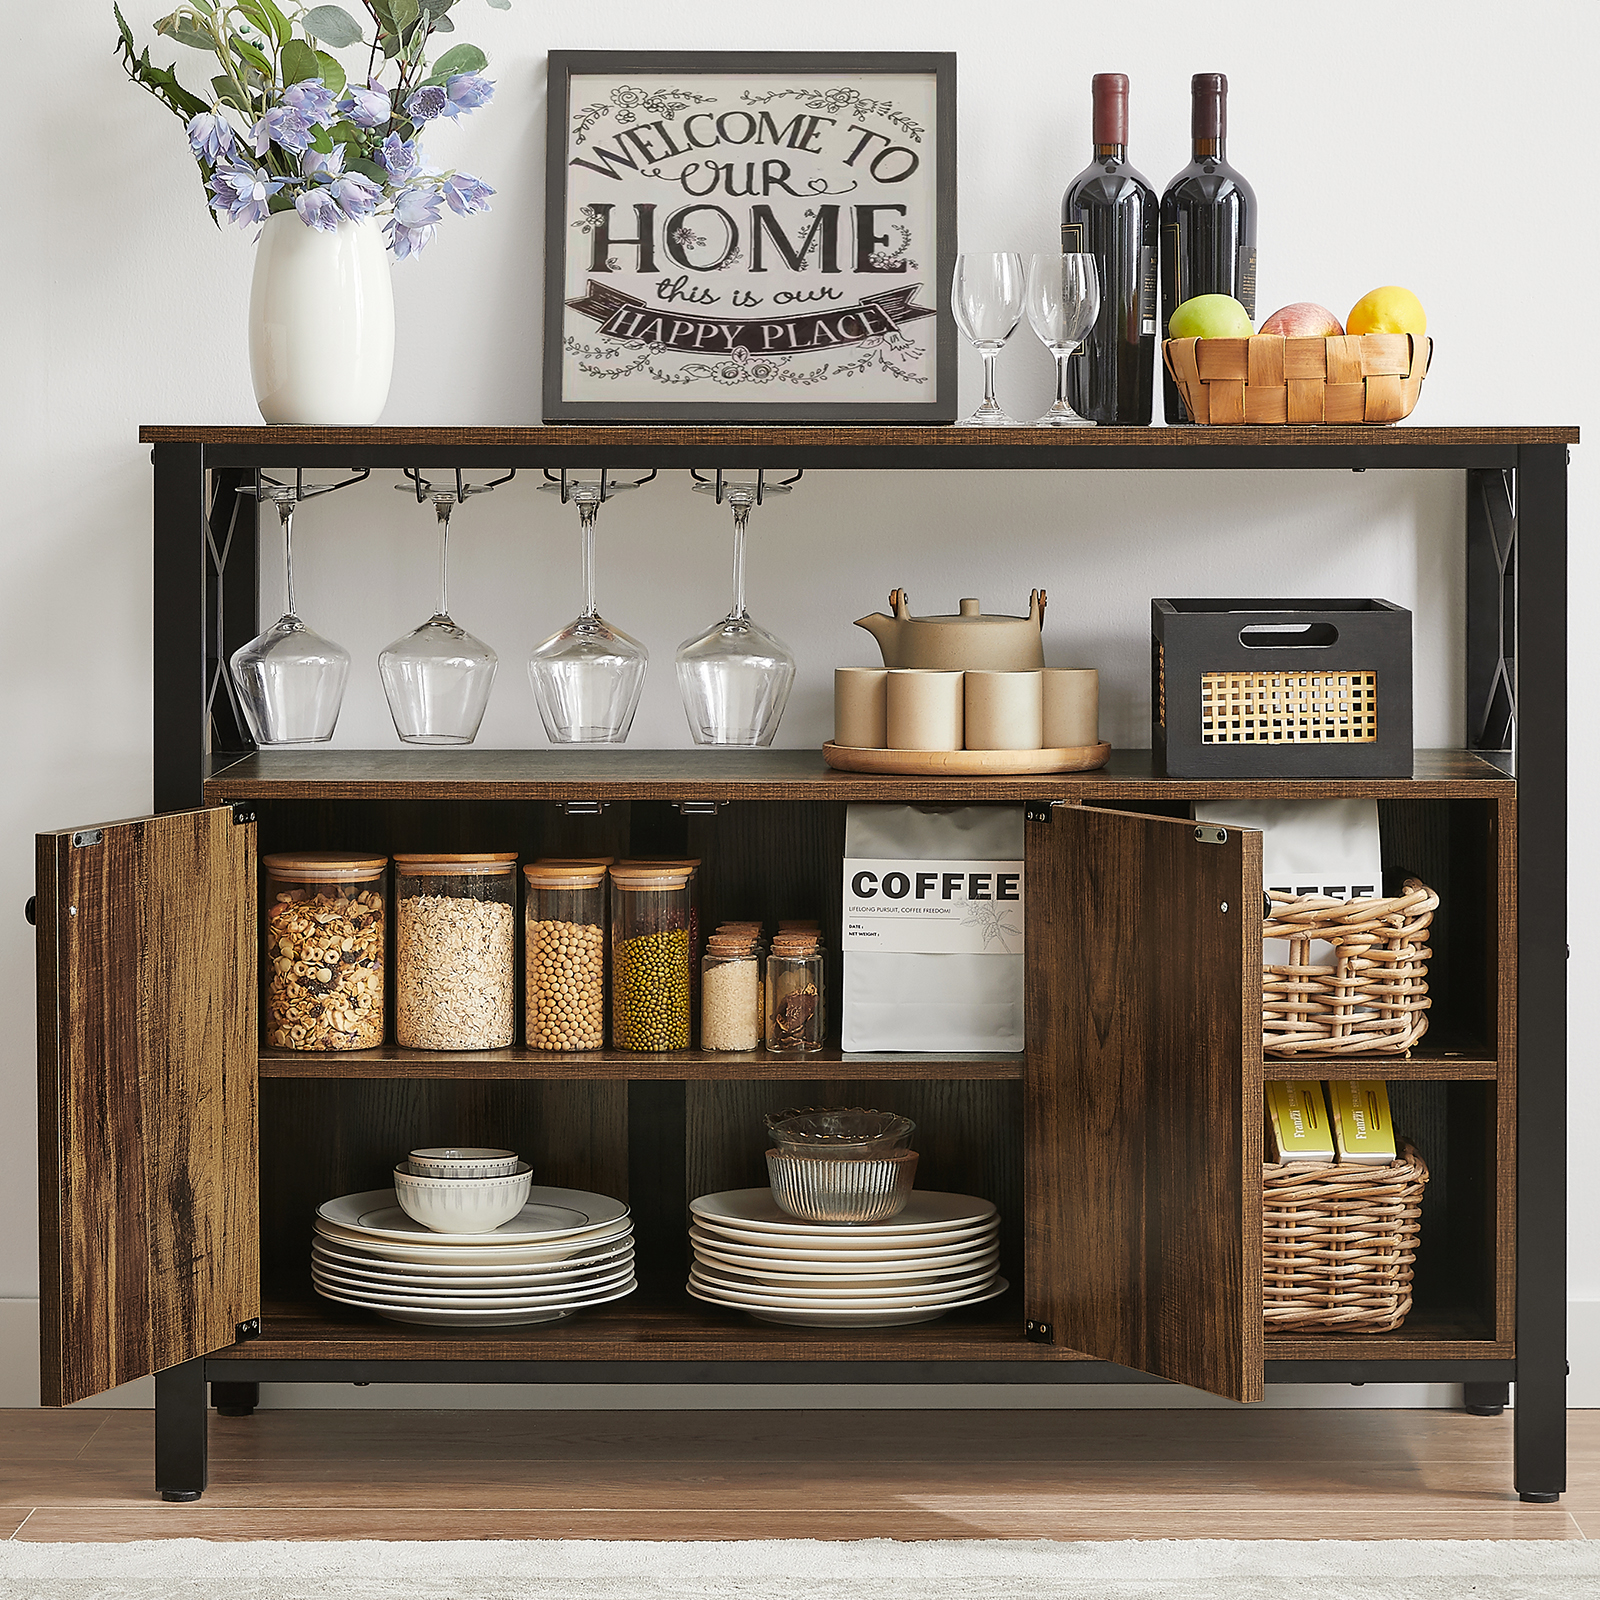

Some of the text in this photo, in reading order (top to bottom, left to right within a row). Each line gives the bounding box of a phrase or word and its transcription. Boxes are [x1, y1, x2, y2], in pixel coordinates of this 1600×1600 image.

[569, 111, 920, 184] WELCOME TO
[587, 203, 908, 274] HOME
[655, 274, 844, 307] this is our
[607, 309, 888, 350] HAPPY PLACE
[851, 871, 1020, 901] COFFEE
